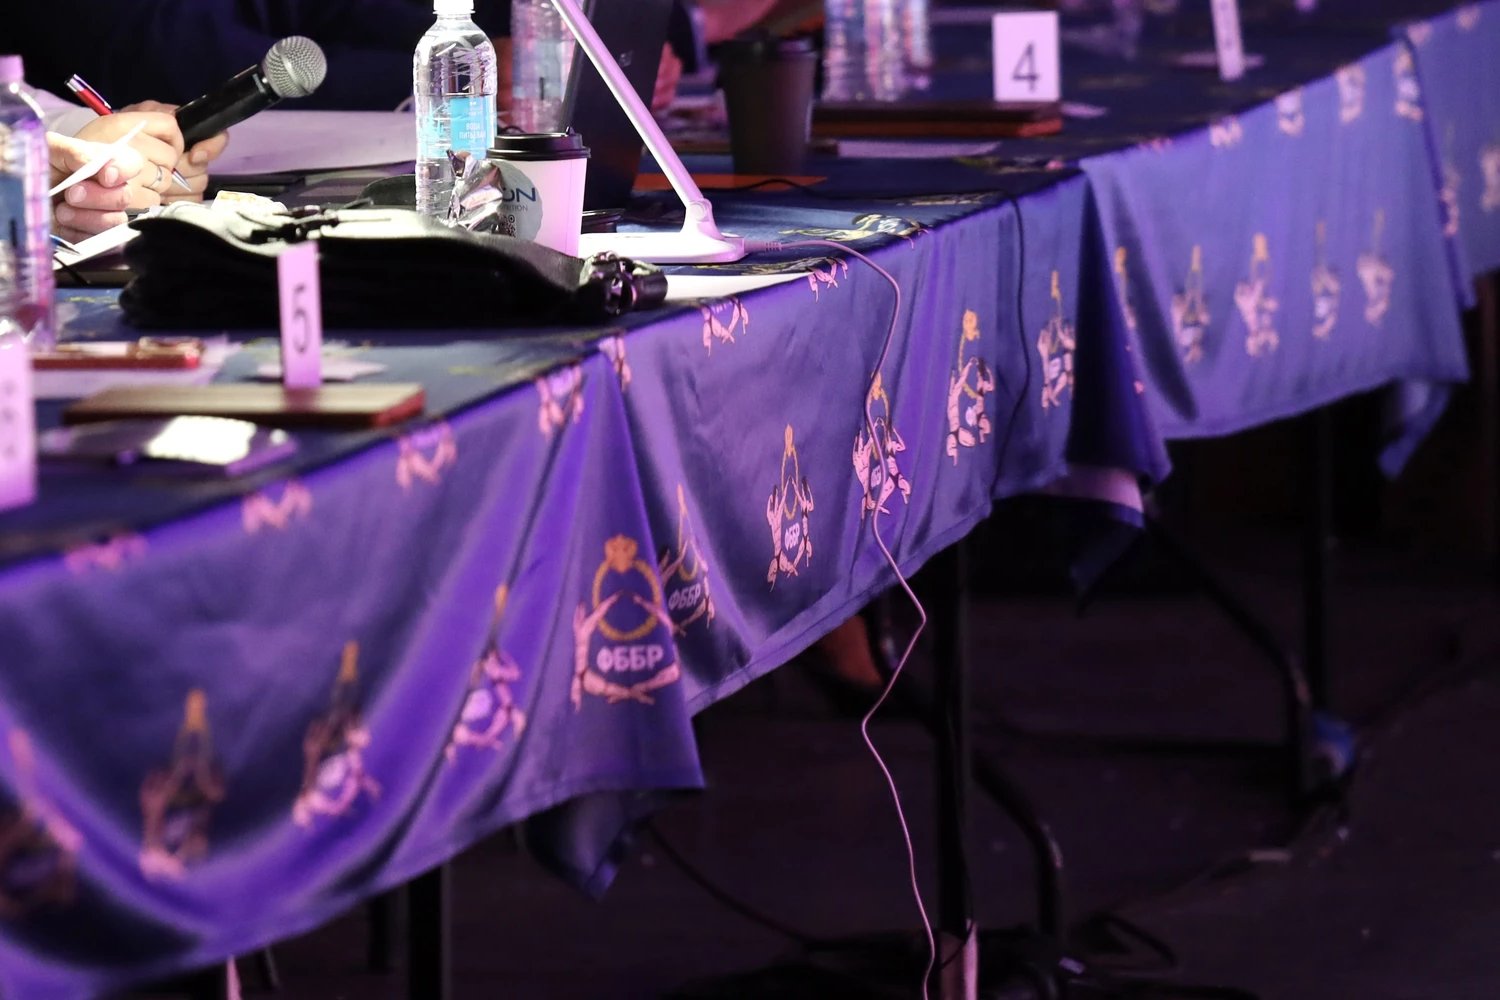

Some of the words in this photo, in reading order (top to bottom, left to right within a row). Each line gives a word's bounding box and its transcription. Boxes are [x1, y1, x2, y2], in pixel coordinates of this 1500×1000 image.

[1011, 42, 1041, 94] 4
[292, 283, 312, 356] 5
[667, 583, 701, 611] ФББР
[596, 644, 664, 674] ФББР
